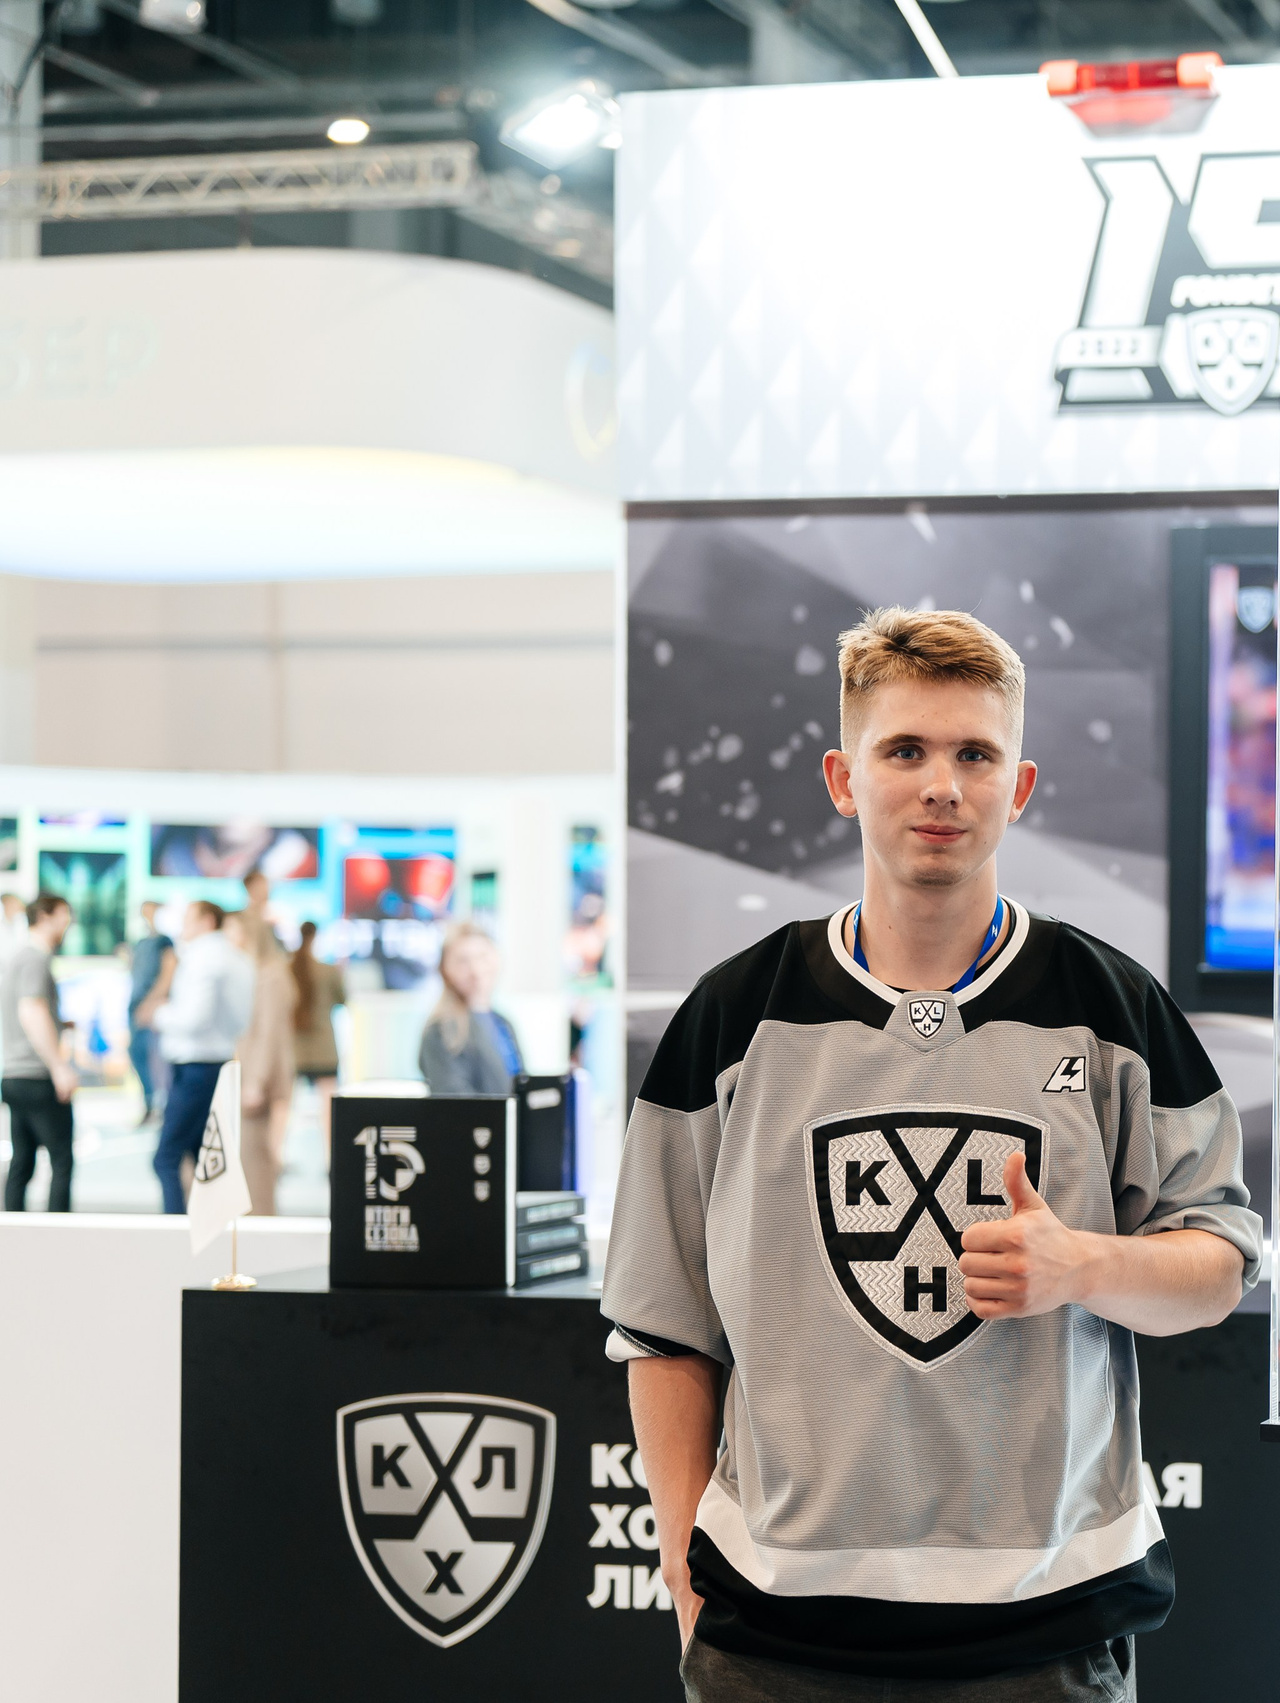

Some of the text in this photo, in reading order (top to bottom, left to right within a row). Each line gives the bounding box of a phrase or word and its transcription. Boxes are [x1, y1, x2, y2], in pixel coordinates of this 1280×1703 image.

[845, 1159, 1007, 1206] K L
[903, 1266, 948, 1312] H
[371, 1444, 517, 1491] К Л
[424, 1550, 464, 1596] Х
